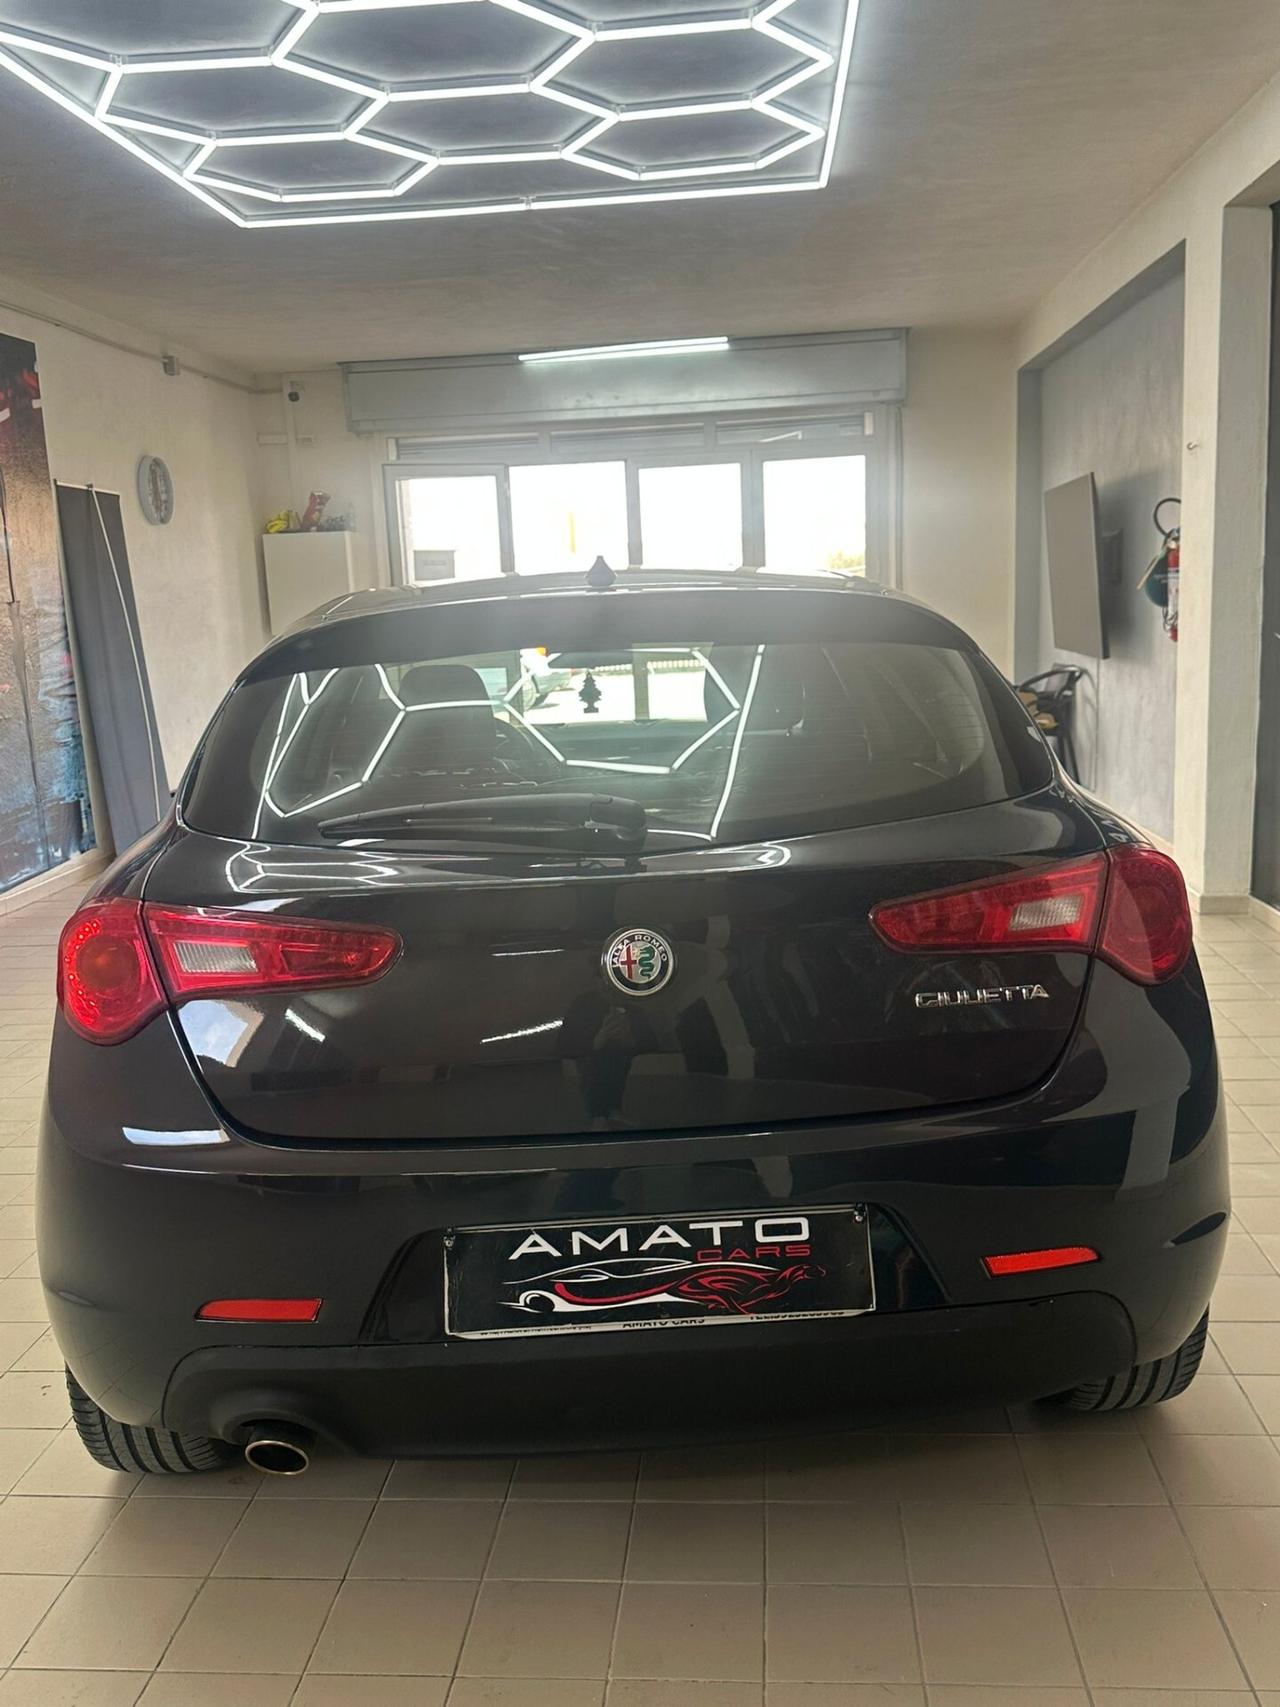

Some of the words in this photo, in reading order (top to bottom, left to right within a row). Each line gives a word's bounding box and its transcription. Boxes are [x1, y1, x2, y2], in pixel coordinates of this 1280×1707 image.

[612, 938, 631, 968] ALFA
[634, 934, 668, 962] ROMEO
[915, 984, 1050, 1008] GIULIETTA
[508, 1216, 810, 1260] AMATO
[697, 1244, 811, 1262] CARS
